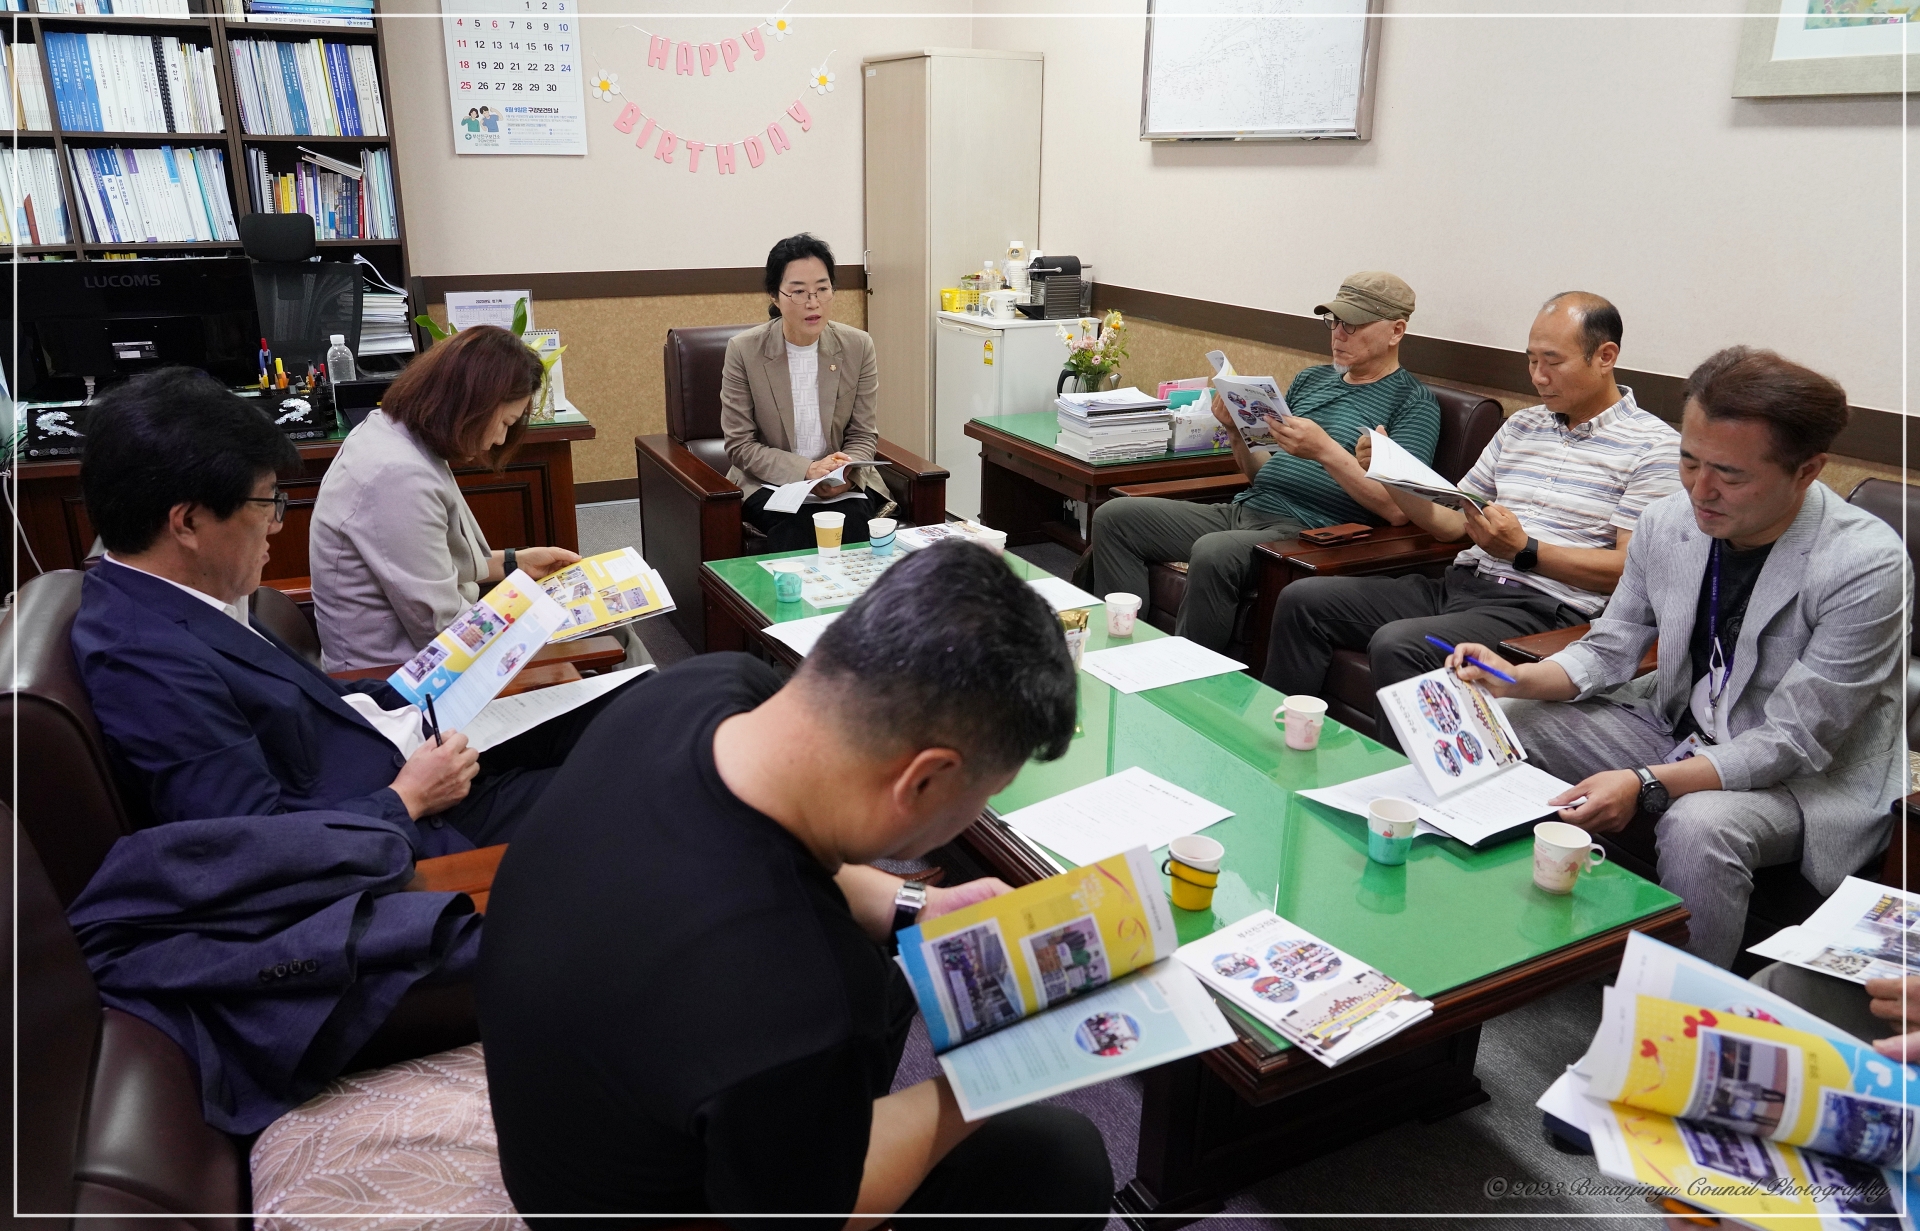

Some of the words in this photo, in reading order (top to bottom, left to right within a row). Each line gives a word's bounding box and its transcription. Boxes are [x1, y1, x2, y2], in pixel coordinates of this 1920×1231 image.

[525, 1, 530, 9] 1
[542, 2, 548, 10] 2
[558, 3, 565, 11] 3
[456, 18, 463, 26] 4
[491, 20, 498, 28] 6
[509, 21, 515, 29] 7
[526, 22, 532, 30] 8
[543, 22, 549, 30] 9
[559, 23, 569, 32] 10
[456, 40, 467, 48] 11
[474, 41, 485, 49] 12
[491, 41, 503, 50] 13
[509, 42, 520, 50] 14
[526, 42, 537, 51] 15
[543, 43, 554, 52] 16
[560, 44, 570, 52] 17
[648, 27, 766, 77] HAPPY
[82, 60, 92, 80] 예산서
[459, 61, 470, 69] 18
[476, 61, 487, 69] 19
[493, 62, 504, 70] 20
[510, 62, 520, 70] 21
[527, 63, 538, 71] 22
[544, 63, 555, 72] 23
[561, 64, 571, 72] 24
[460, 81, 472, 90] 25
[477, 82, 489, 90] 26
[495, 82, 506, 91] 27
[512, 83, 523, 91] 28
[529, 83, 540, 91] 29
[613, 100, 813, 175] BIRTHDAY
[83, 274, 161, 288] LUCOMS
